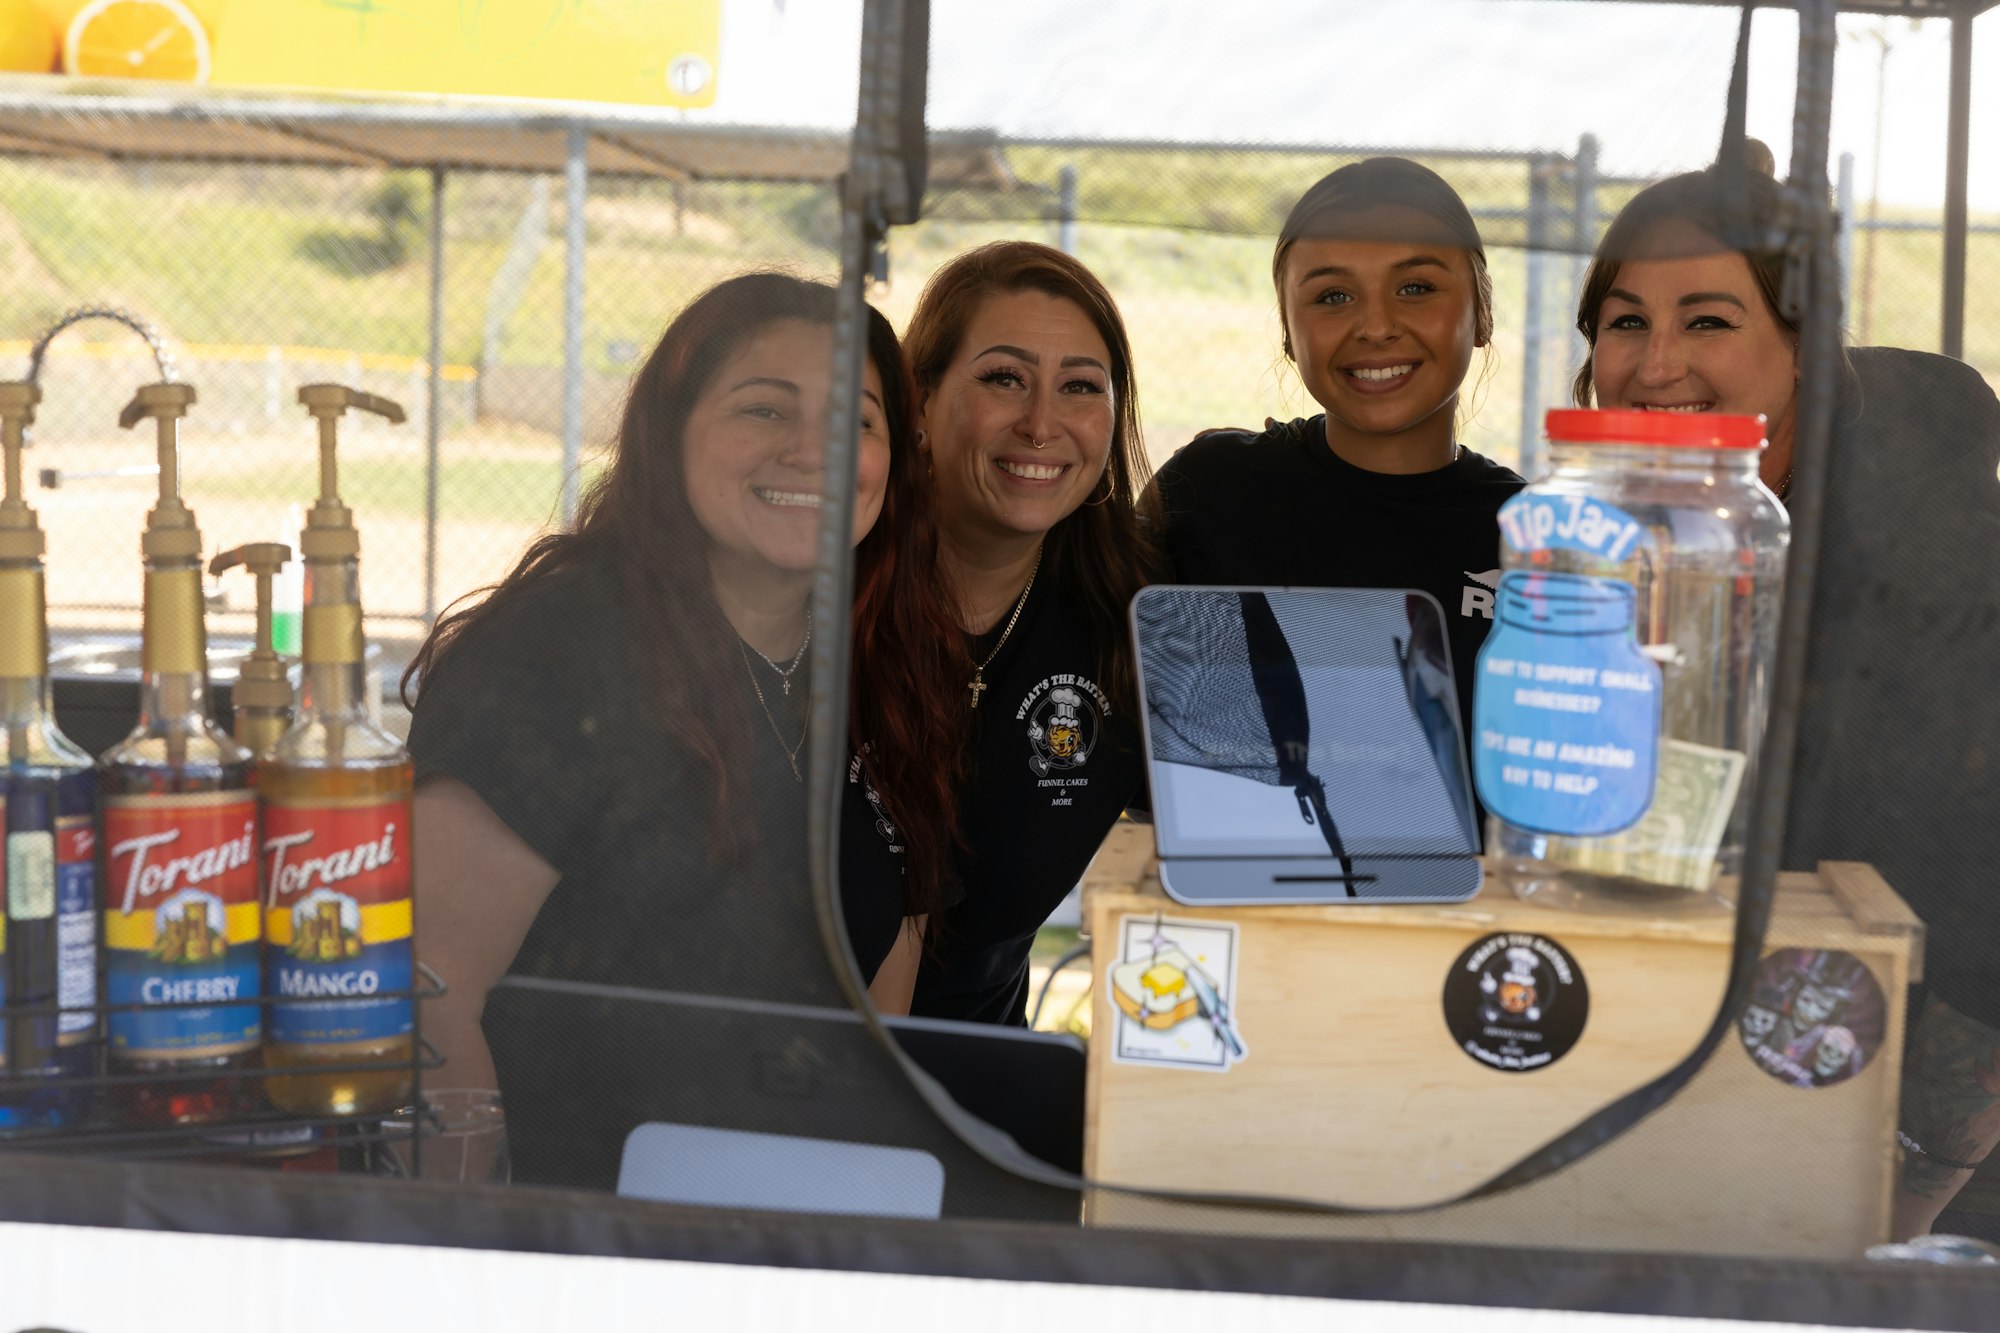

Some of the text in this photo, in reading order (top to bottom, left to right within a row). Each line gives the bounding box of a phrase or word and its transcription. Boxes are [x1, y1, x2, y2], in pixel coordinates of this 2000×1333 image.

[1499, 502, 1555, 550] Tip
[1517, 661, 1533, 679] TO
[1535, 664, 1597, 686] SUPPORT
[1601, 670, 1653, 691] SMALL
[1016, 678, 1049, 720] WHAT'S
[1051, 674, 1075, 685] THE
[1506, 736, 1531, 756] ARE
[1534, 740, 1556, 760] AN
[1038, 779, 1065, 787] FUNNEL
[1532, 769, 1552, 789] TO
[1554, 773, 1598, 795] HELP
[111, 820, 254, 916] Torani
[264, 822, 396, 910] Torani
[142, 976, 240, 1005] CHERRY
[280, 968, 379, 996] MANGO
